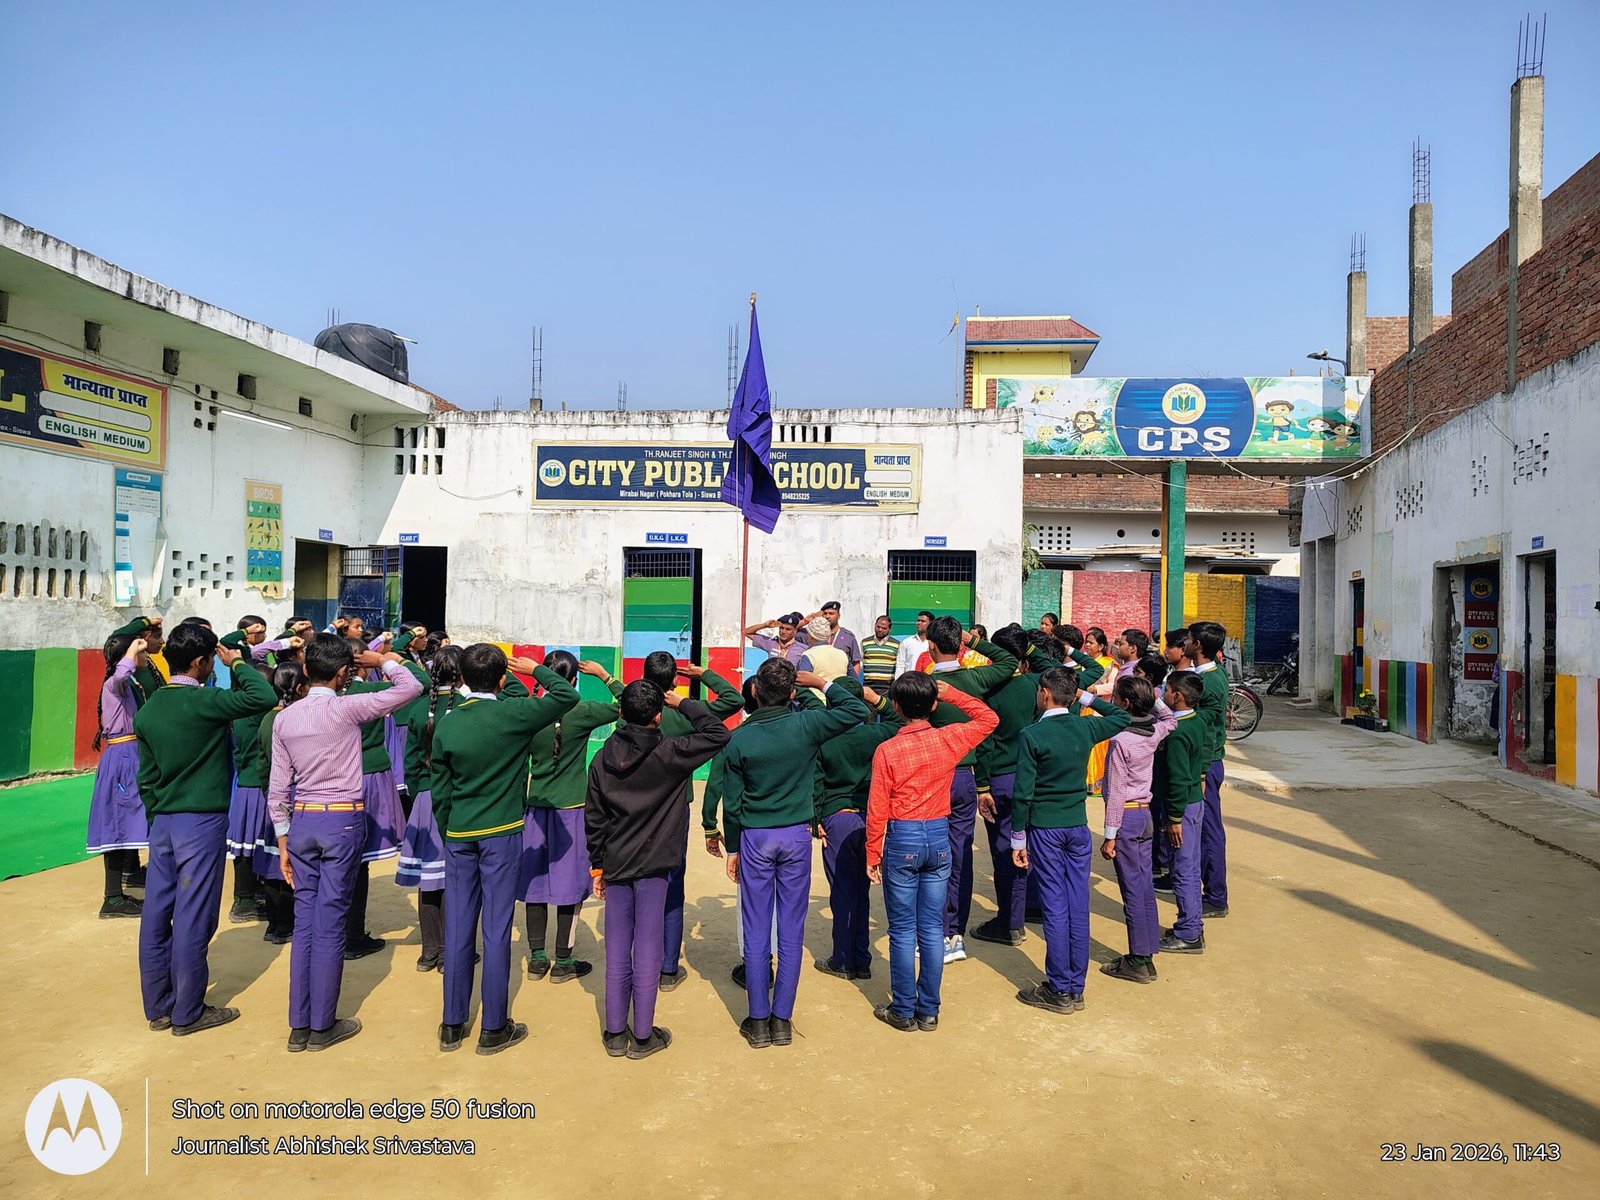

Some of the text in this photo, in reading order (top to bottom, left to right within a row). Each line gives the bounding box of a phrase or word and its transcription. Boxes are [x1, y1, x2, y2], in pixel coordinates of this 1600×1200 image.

[62, 374, 148, 408] मान्यता प्राप्त
[12, 426, 31, 436] Siswa
[45, 420, 145, 450] ENGLISH MEDIUM
[1138, 426, 1231, 451] CPS
[644, 450, 686, 459] TH.RANJEET
[687, 450, 710, 459] SINGH
[711, 451, 717, 459] &
[769, 451, 787, 460] INGH
[873, 455, 911, 466] मान्यता प्राप्त
[568, 459, 860, 490] CITY PUBLI CHOOL
[253, 487, 274, 500] BIRDS
[619, 490, 639, 498] Mirabai
[639, 490, 655, 499] Nagar
[660, 490, 681, 499] Pokhara
[681, 491, 693, 499] Tola
[701, 491, 716, 499] Siswa
